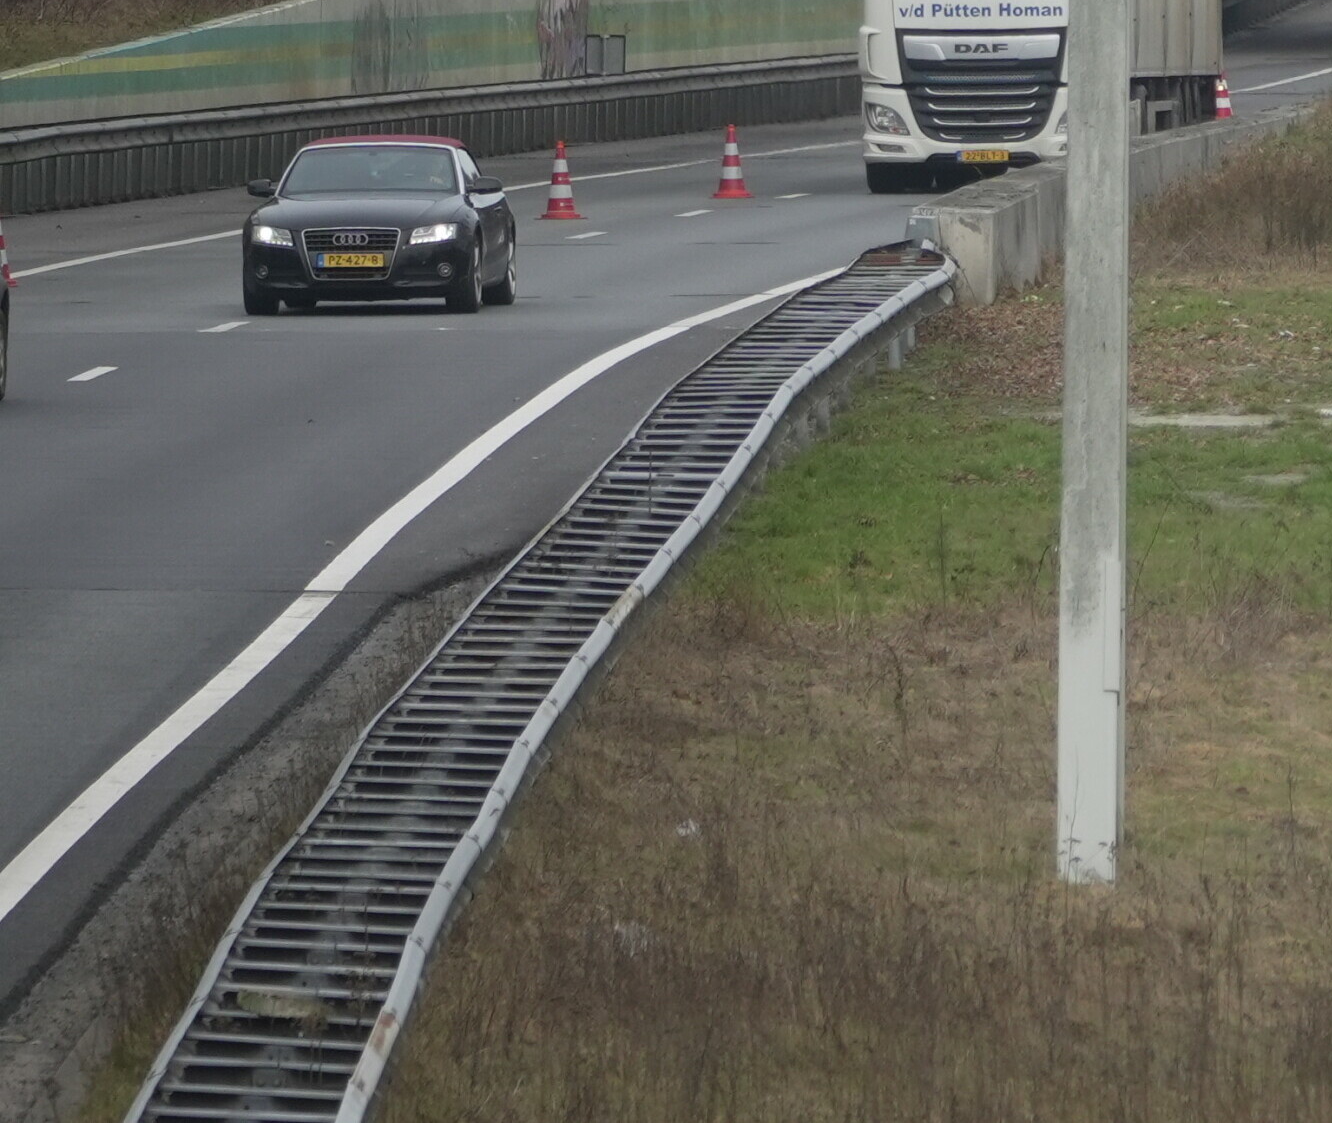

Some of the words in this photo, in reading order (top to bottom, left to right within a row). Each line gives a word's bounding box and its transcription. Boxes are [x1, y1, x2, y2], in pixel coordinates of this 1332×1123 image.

[898, 3, 925, 18] v/d
[931, 3, 992, 18] Pütten
[999, 3, 1064, 18] Homan
[954, 43, 1009, 54] DAF
